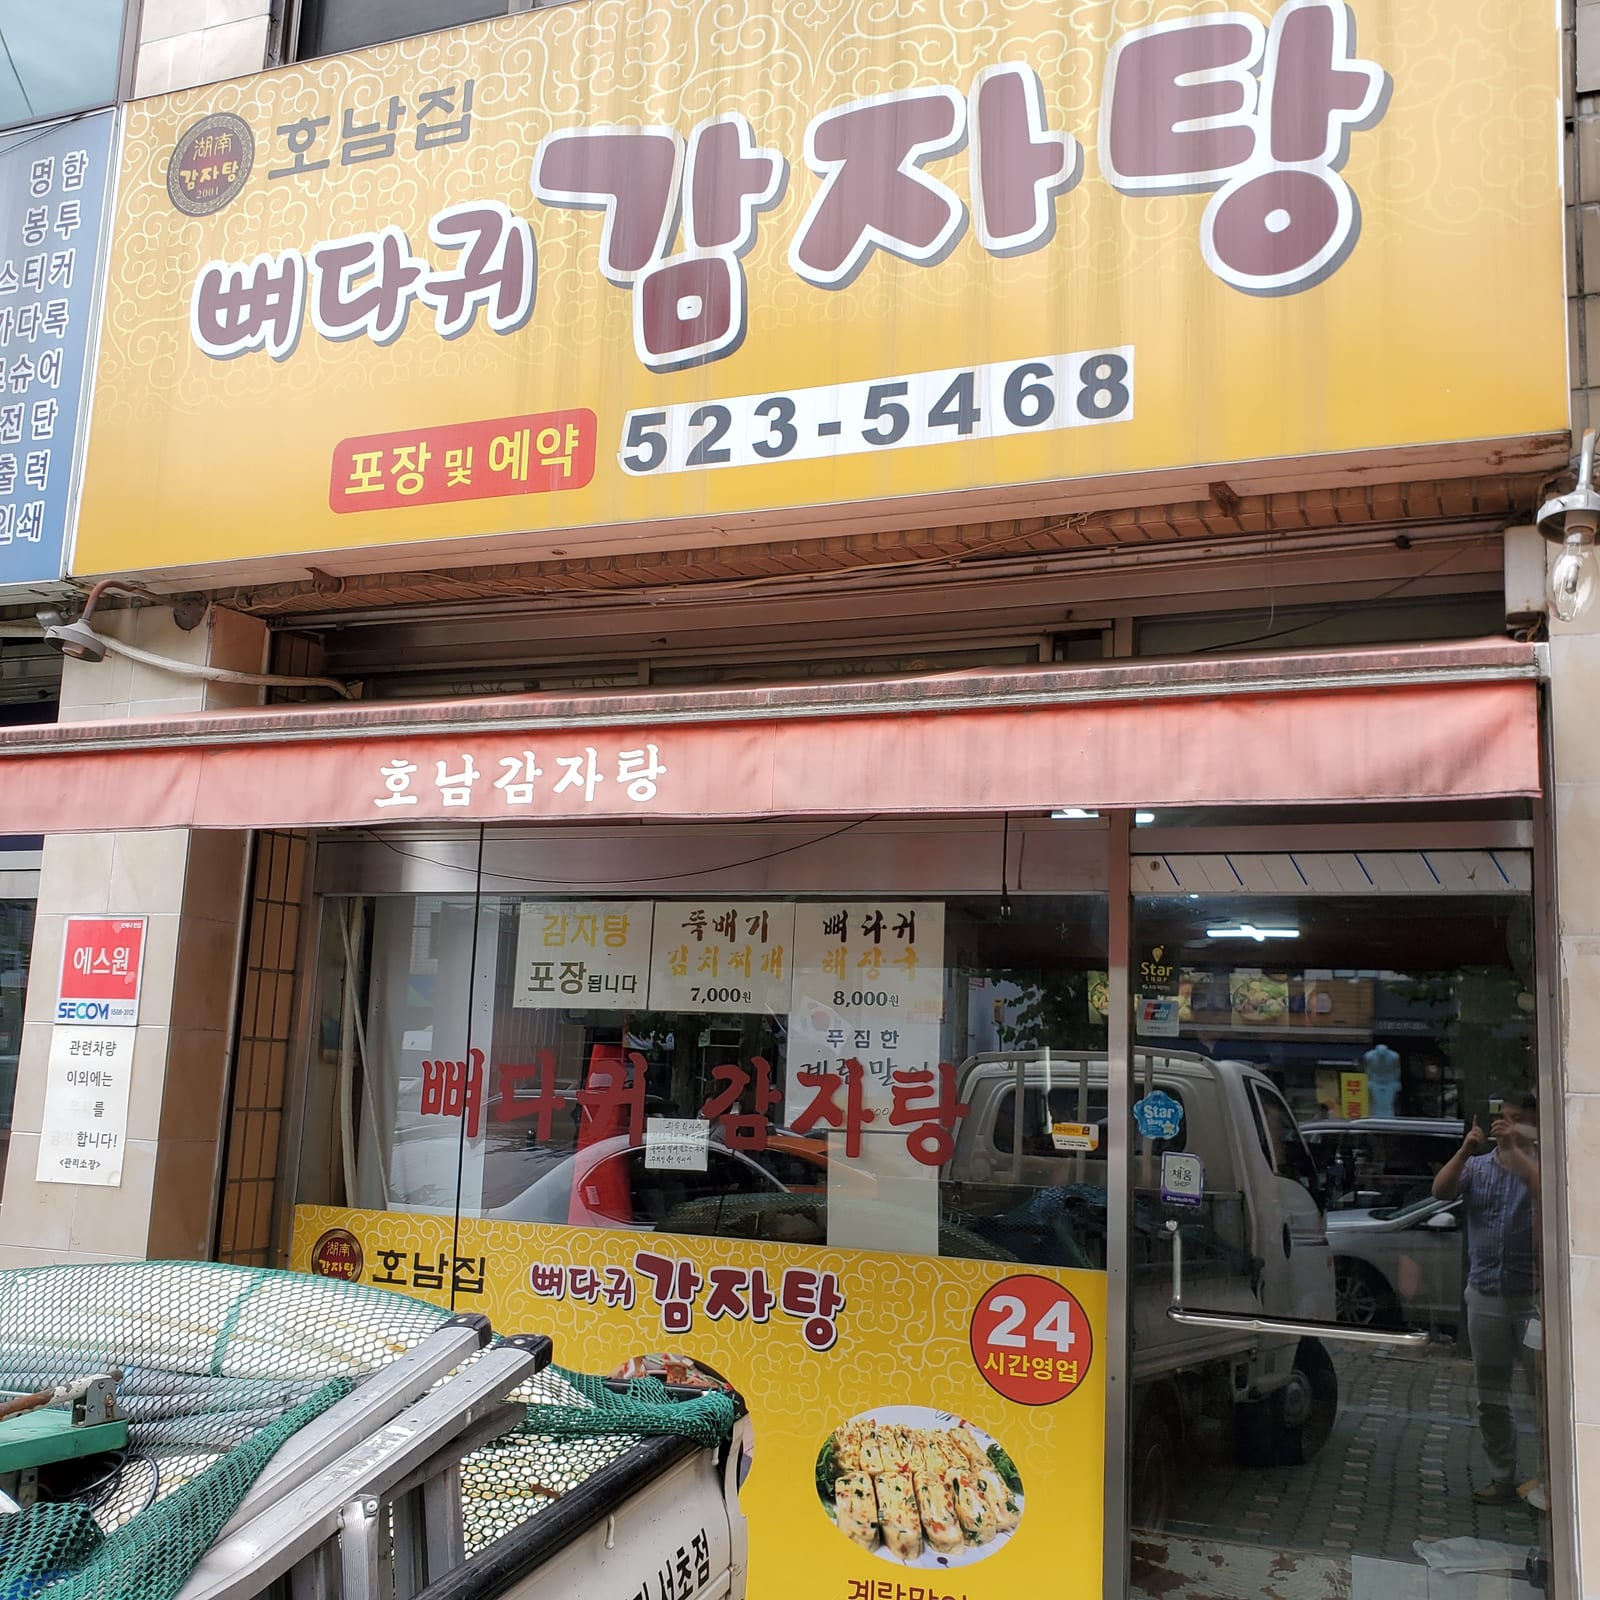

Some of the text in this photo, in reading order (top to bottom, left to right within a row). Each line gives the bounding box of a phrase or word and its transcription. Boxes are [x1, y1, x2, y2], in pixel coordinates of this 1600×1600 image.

[193, 132, 233, 160] 湖南
[267, 79, 476, 180] 호남집
[30, 150, 88, 198] 명함
[180, 160, 239, 191] 감자탕
[190, 0, 1394, 373] 뼈다귀 감자탕
[196, 186, 219, 199] 2001
[23, 200, 81, 245] 봉투
[0, 248, 76, 295] 스티커
[0, 398, 58, 444] 전단
[623, 354, 1130, 472] 523-5468
[343, 423, 580, 495] 포장 및 예약
[373, 743, 669, 808] 호남감자탕
[542, 913, 630, 948] 감자탕
[681, 910, 770, 943] 뚝배기
[822, 910, 917, 945] 뼈다귀
[73, 946, 130, 976] 에스원
[527, 961, 638, 995] 포장됩니다
[667, 944, 786, 980] 김치찌개
[819, 946, 921, 982] 해장국
[1141, 962, 1173, 977] Star
[58, 1002, 109, 1020] SECOM
[690, 987, 752, 1004] 7,000원
[833, 990, 901, 1009] 8,000원
[68, 1039, 118, 1057] 관련차량
[826, 1029, 900, 1050] 푸짐한
[66, 1070, 114, 1088] 이외에는
[420, 1047, 969, 1167] 뼈다귀 감자탕
[1143, 1104, 1175, 1119] Star
[76, 1131, 118, 1149] 합니다!
[59, 1157, 101, 1171] <관리소장>
[318, 1258, 354, 1277] 감자탕
[372, 1250, 485, 1294] 호남집
[530, 1250, 847, 1351] 뼈다귀 감자탕
[986, 1295, 1075, 1353] 24
[983, 1353, 1079, 1385] 시간영업
